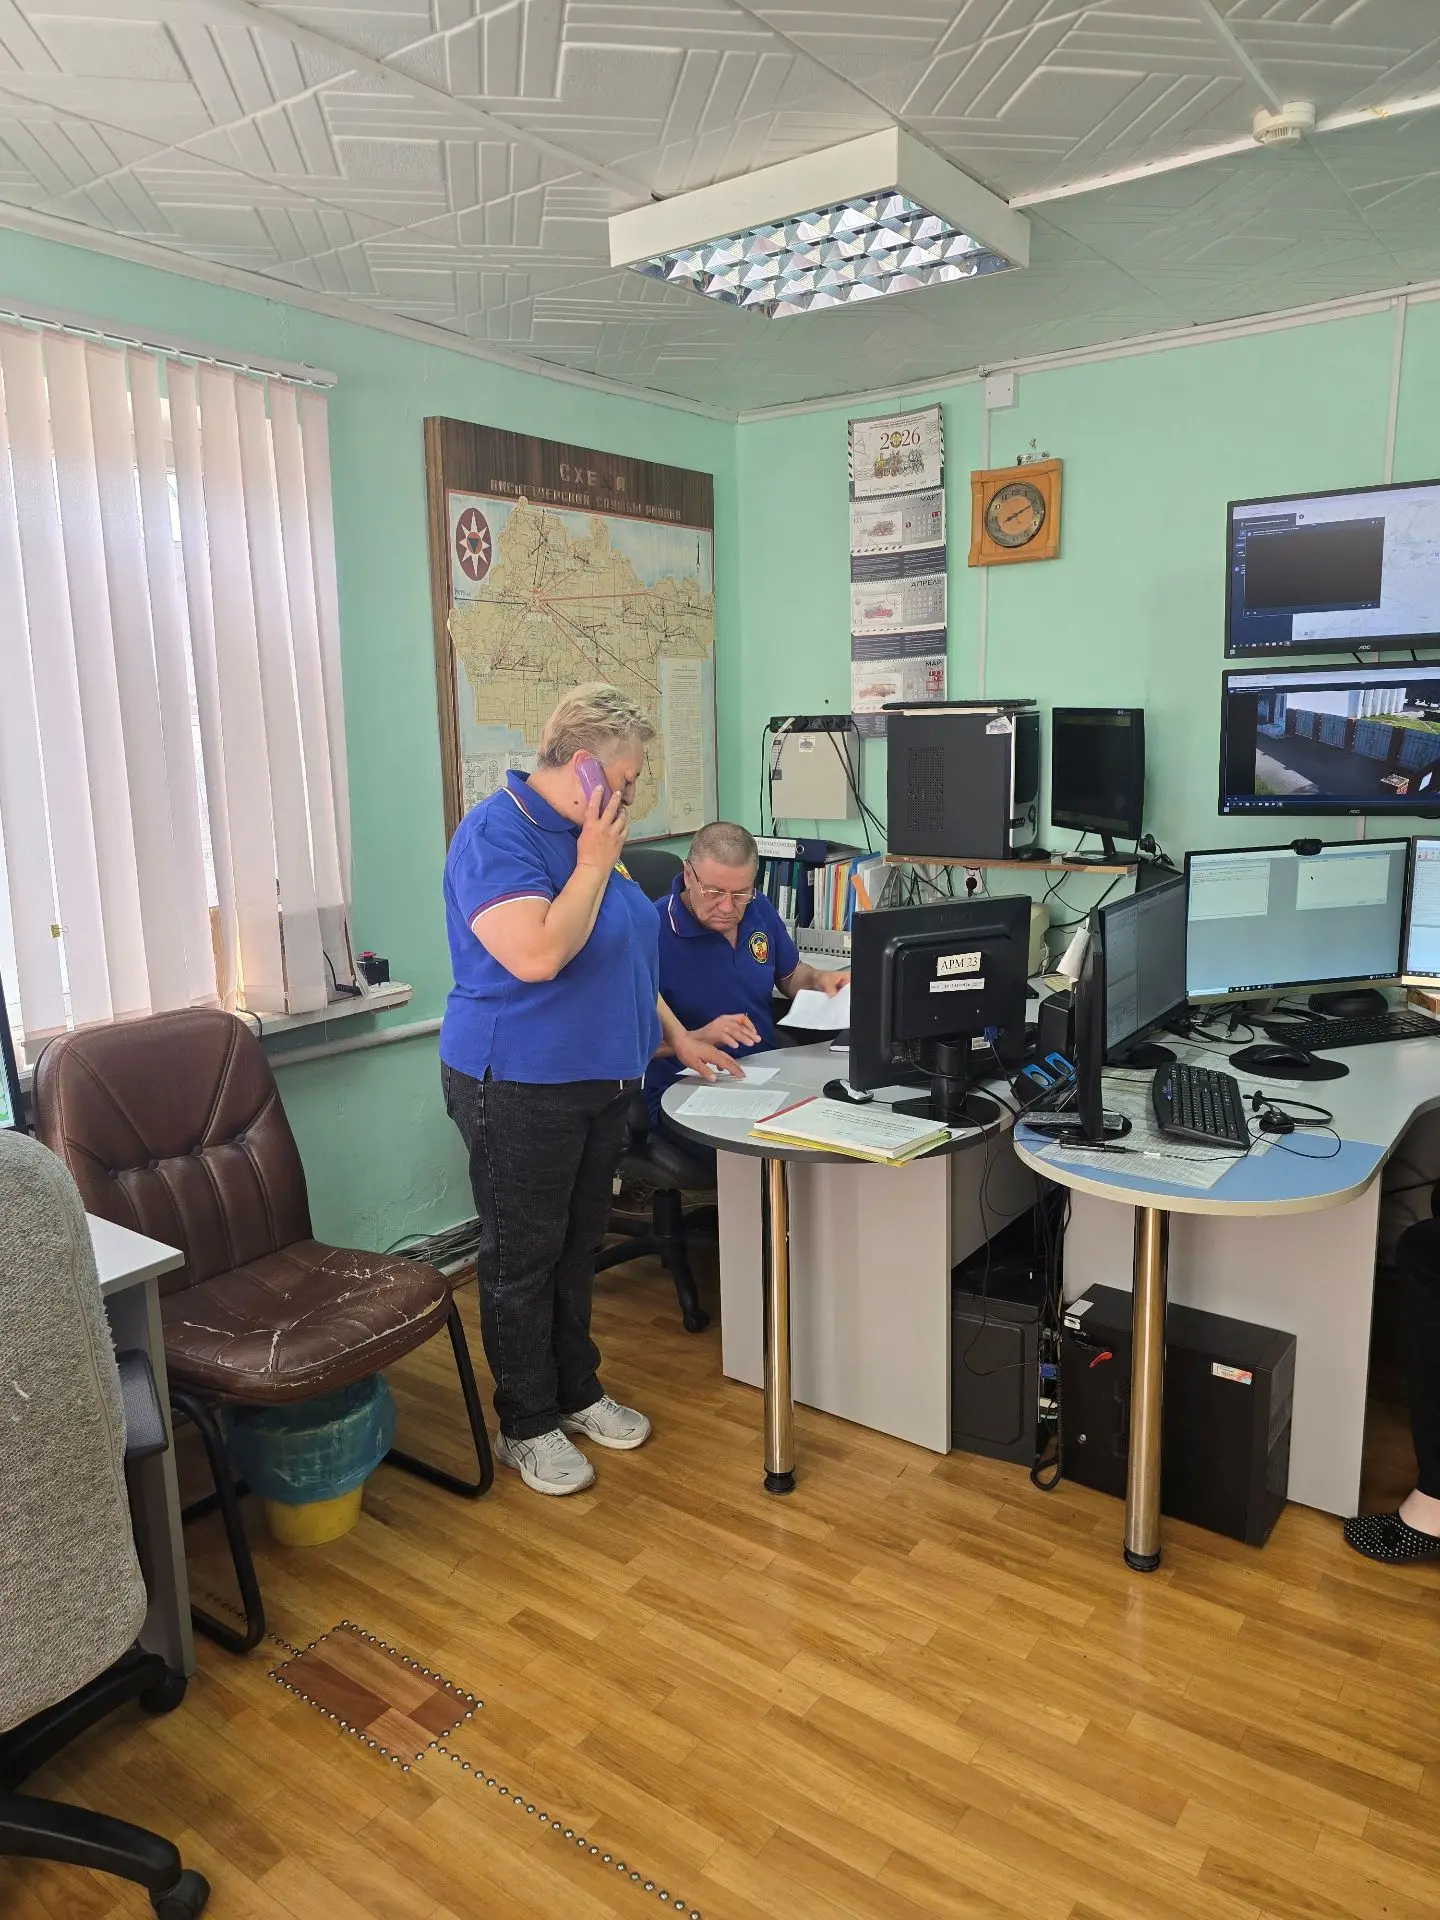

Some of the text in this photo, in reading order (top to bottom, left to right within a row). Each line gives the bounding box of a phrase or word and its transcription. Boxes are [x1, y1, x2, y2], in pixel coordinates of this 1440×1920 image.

[880, 427, 921, 450] 2026
[560, 463, 625, 492] СХЕА
[911, 579, 942, 588] АПРЕЛЬ
[925, 659, 942, 667] МАЙ
[966, 956, 978, 967] 23
